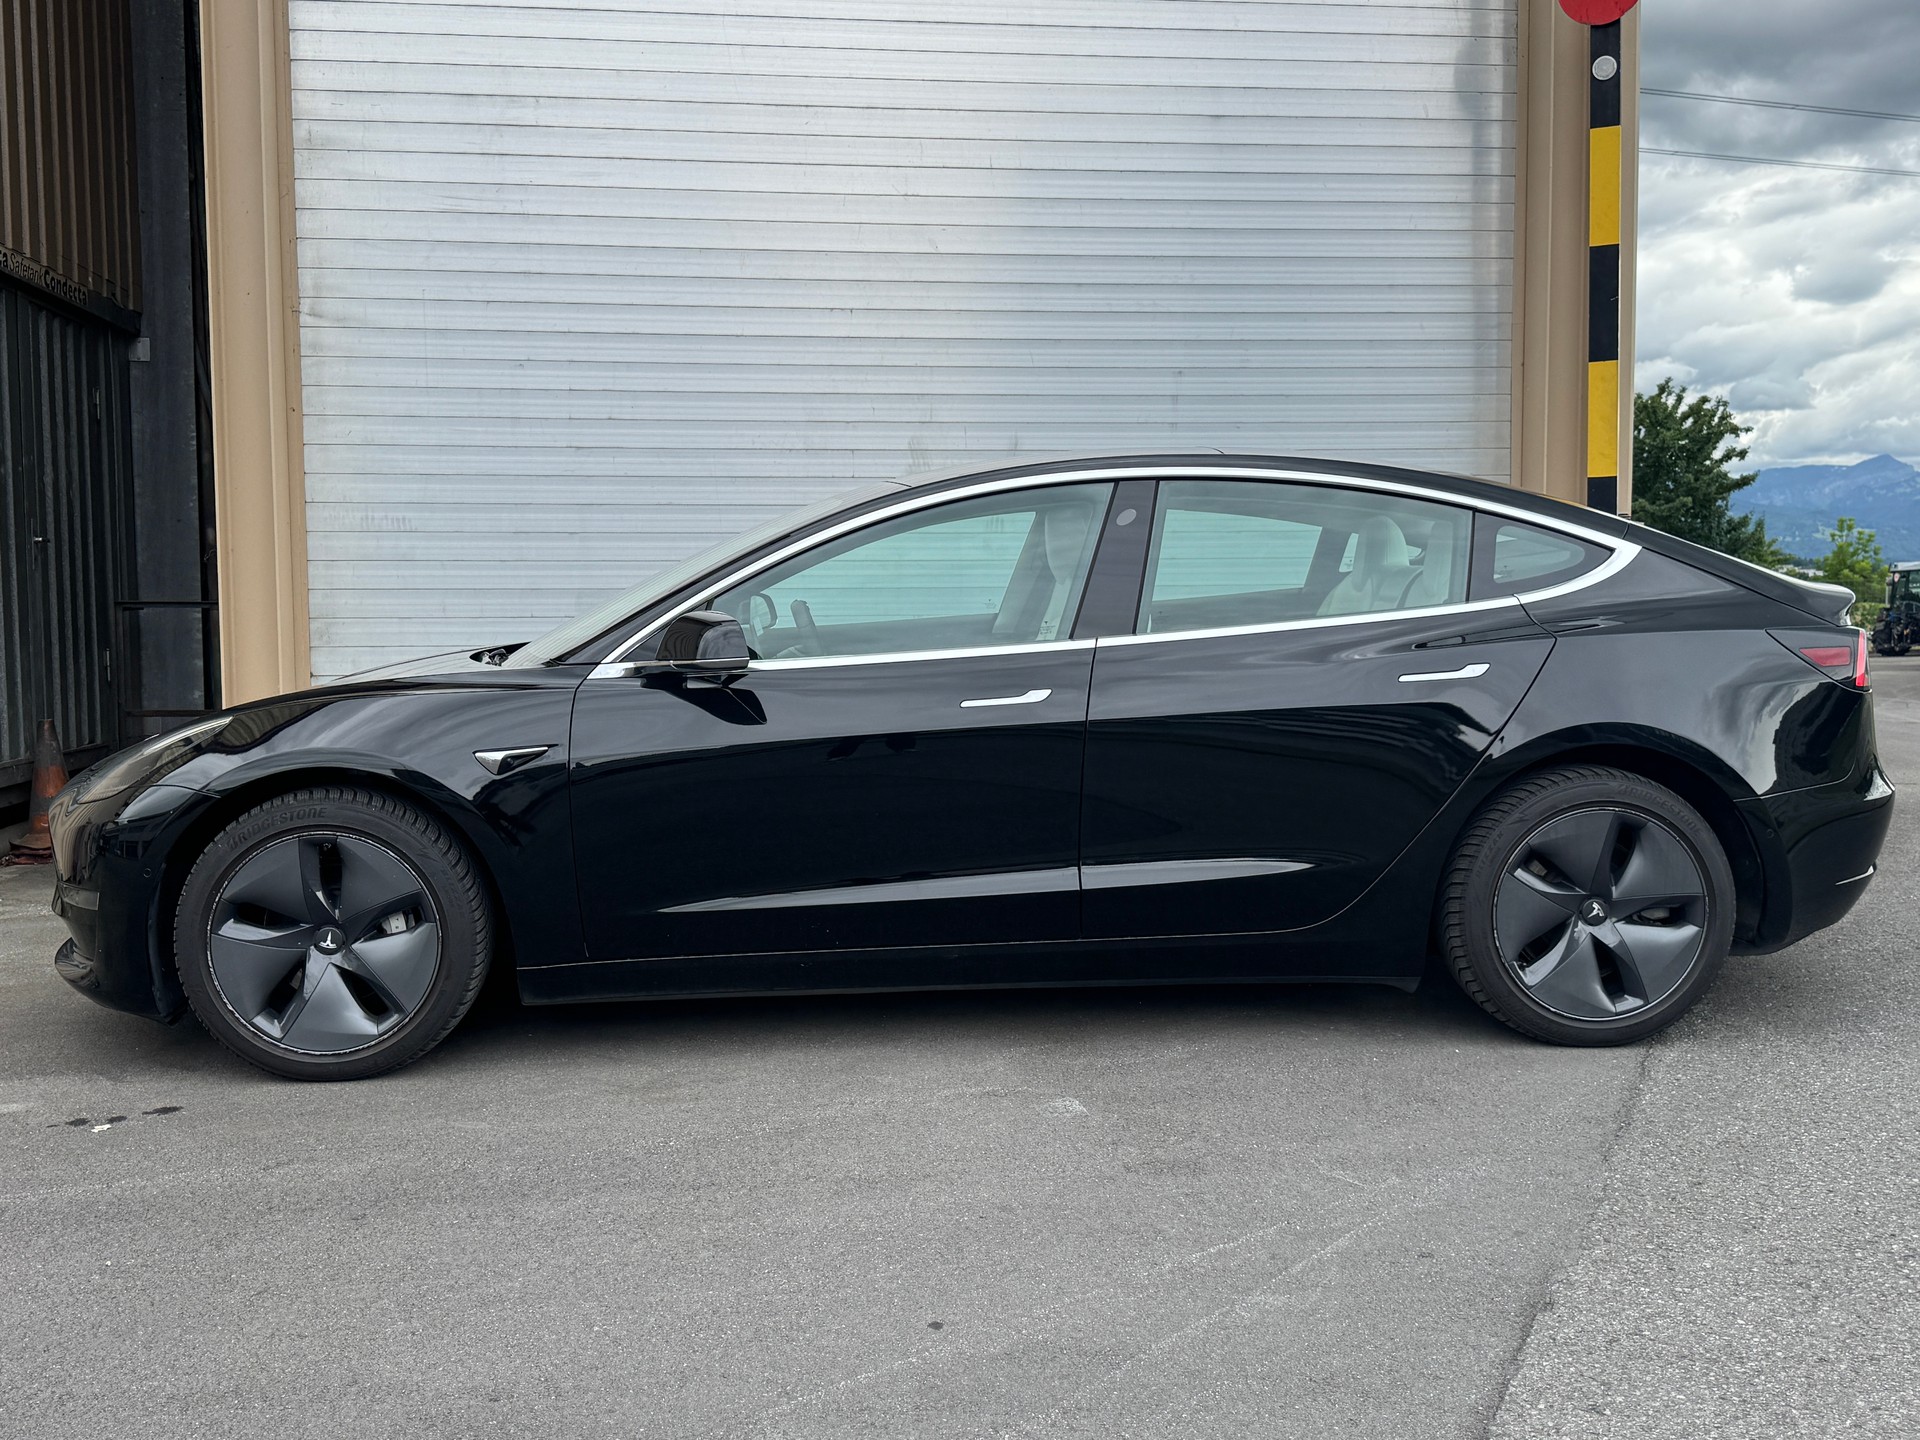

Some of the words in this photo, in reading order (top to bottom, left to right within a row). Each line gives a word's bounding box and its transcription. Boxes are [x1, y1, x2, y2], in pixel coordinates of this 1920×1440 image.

[10, 253, 43, 286] Safetank
[44, 269, 87, 305] Condecta
[225, 807, 328, 850] BRIDGESTONE
[1617, 784, 1702, 837] BRIDGESTONE
